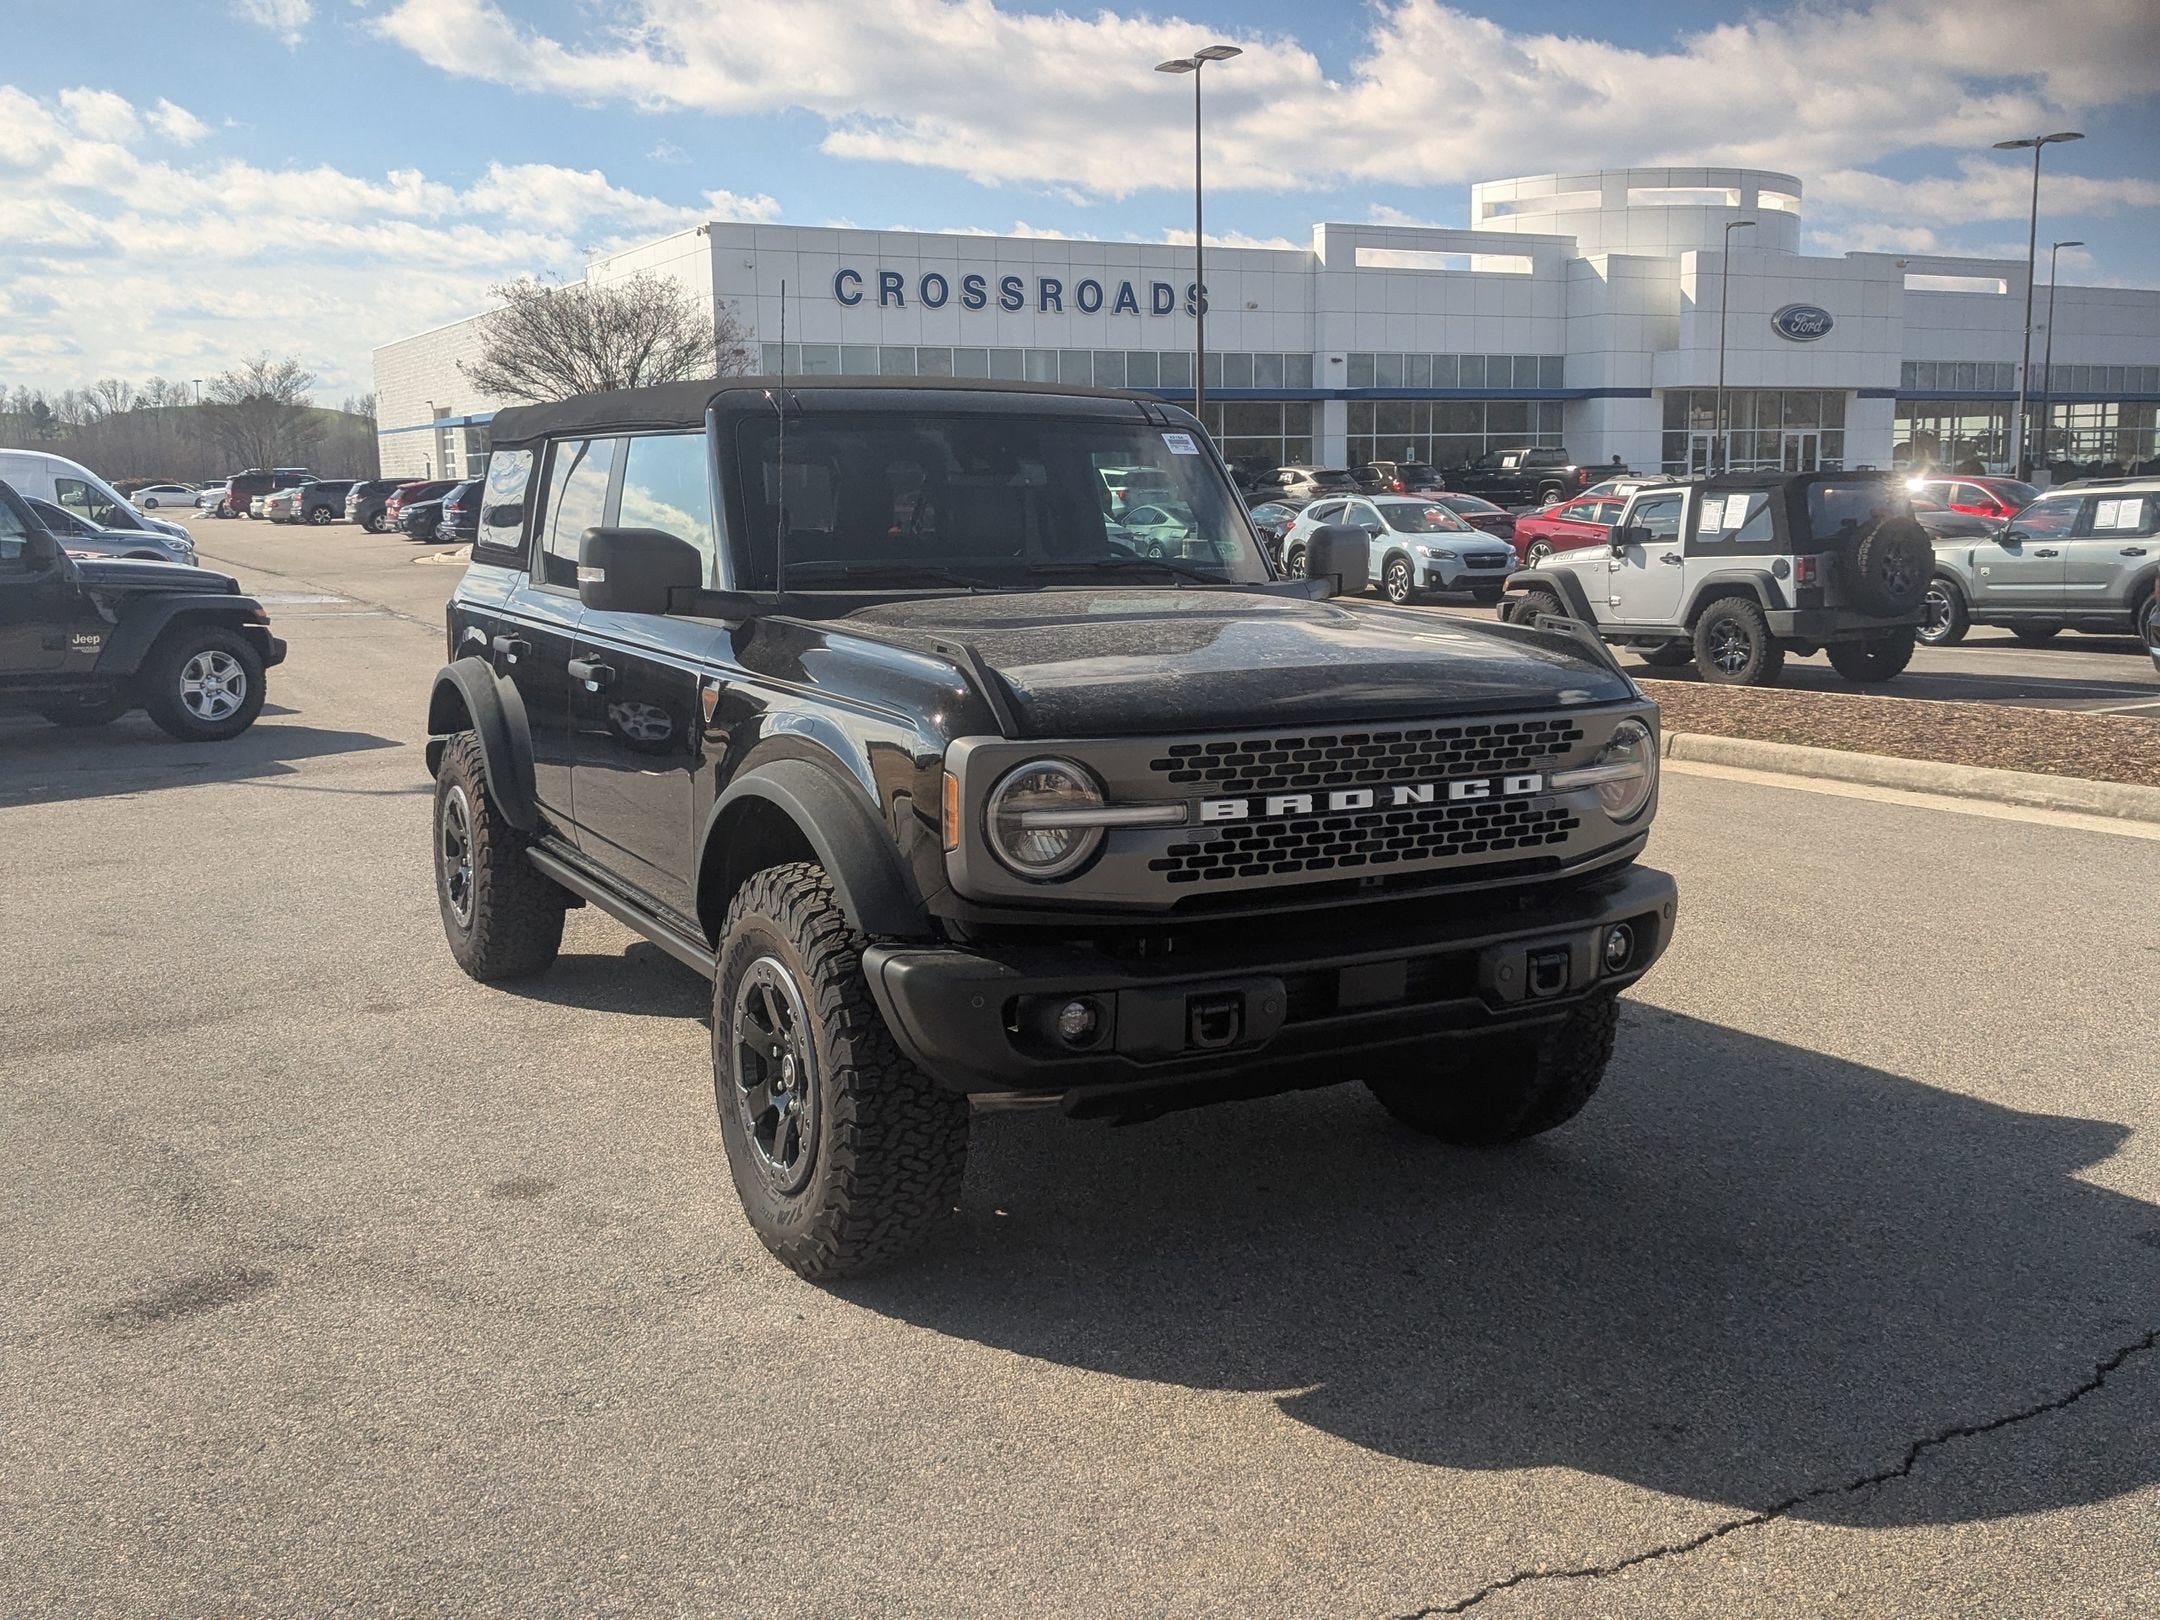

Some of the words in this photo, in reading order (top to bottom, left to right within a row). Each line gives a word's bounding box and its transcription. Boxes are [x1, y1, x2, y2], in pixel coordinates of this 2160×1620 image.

[833, 268, 1209, 318] CROSSROADS
[1790, 312, 1825, 332] Ford
[72, 633, 101, 645] Jeep
[1200, 774, 1543, 822] BRONCO
